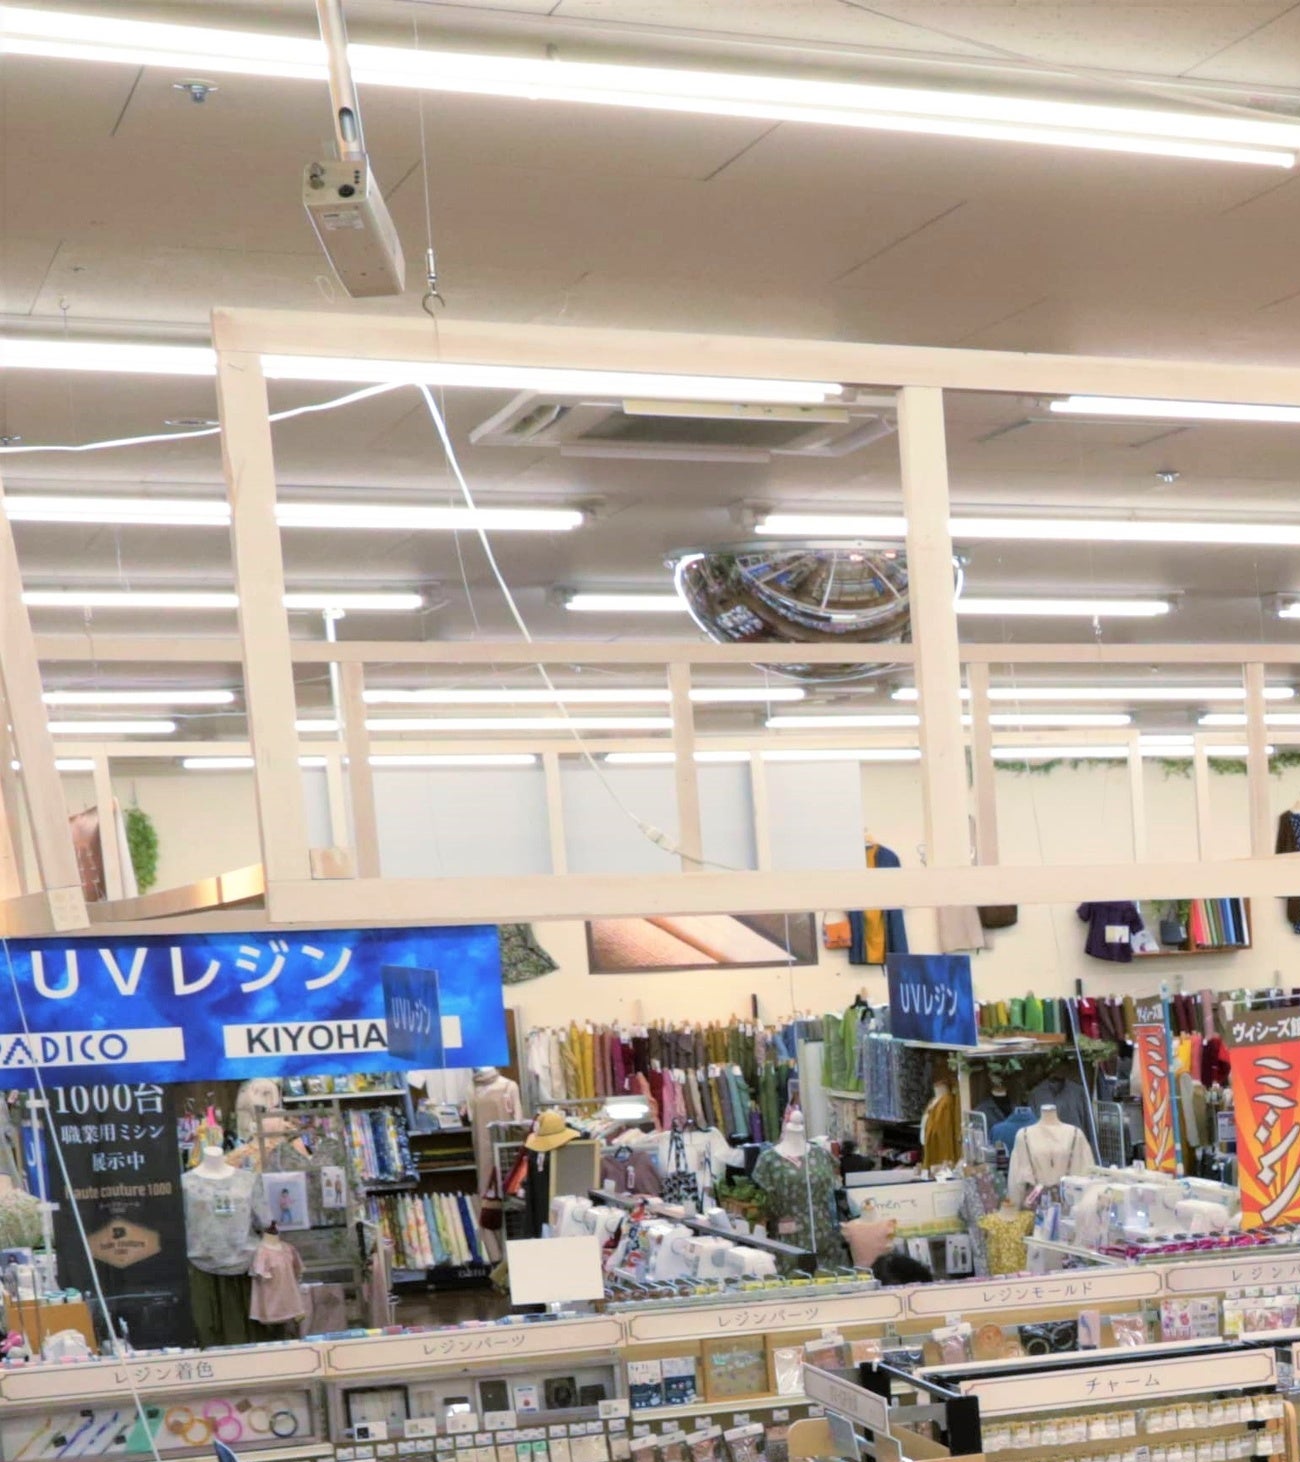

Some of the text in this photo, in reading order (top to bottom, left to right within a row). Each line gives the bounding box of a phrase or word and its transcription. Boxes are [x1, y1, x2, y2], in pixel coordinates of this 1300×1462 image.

[31, 940, 352, 999] UVレジン
[900, 977, 959, 1017] UVレジン
[0, 1033, 128, 1065] ADICO
[247, 1023, 387, 1054] KIYOHA
[52, 1082, 164, 1115] 1000台
[61, 1123, 165, 1144] 職業用ミシン
[92, 1152, 146, 1172] 展示中
[982, 1280, 1093, 1303] レジンモールド
[716, 1304, 820, 1328] レジンパーツ
[422, 1333, 527, 1356] レジンパーツ
[112, 1358, 215, 1383] レジン着色
[1085, 1372, 1161, 1396] チャーム
